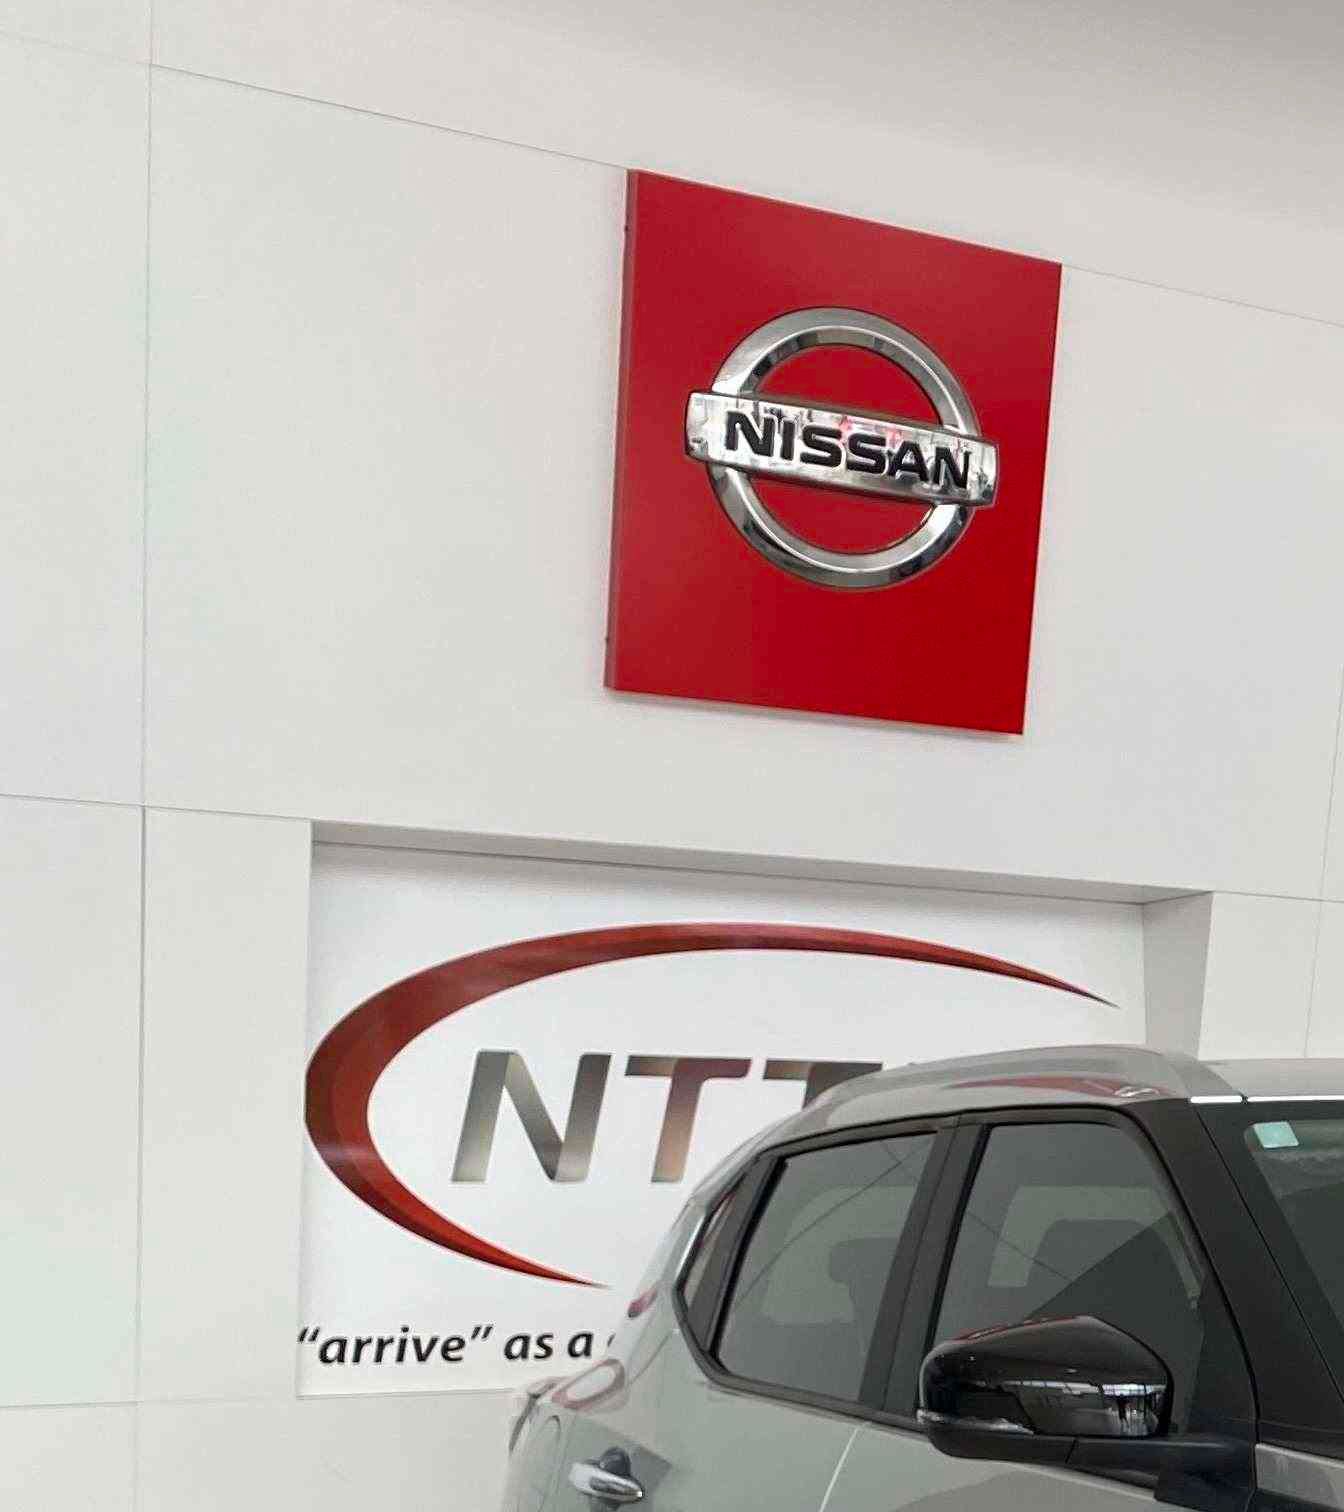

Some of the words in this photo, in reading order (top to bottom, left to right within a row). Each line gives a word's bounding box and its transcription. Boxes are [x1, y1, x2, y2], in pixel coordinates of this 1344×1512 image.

[725, 410, 971, 489] NISSAN
[502, 1331, 557, 1362] as
[566, 1332, 594, 1360] a
